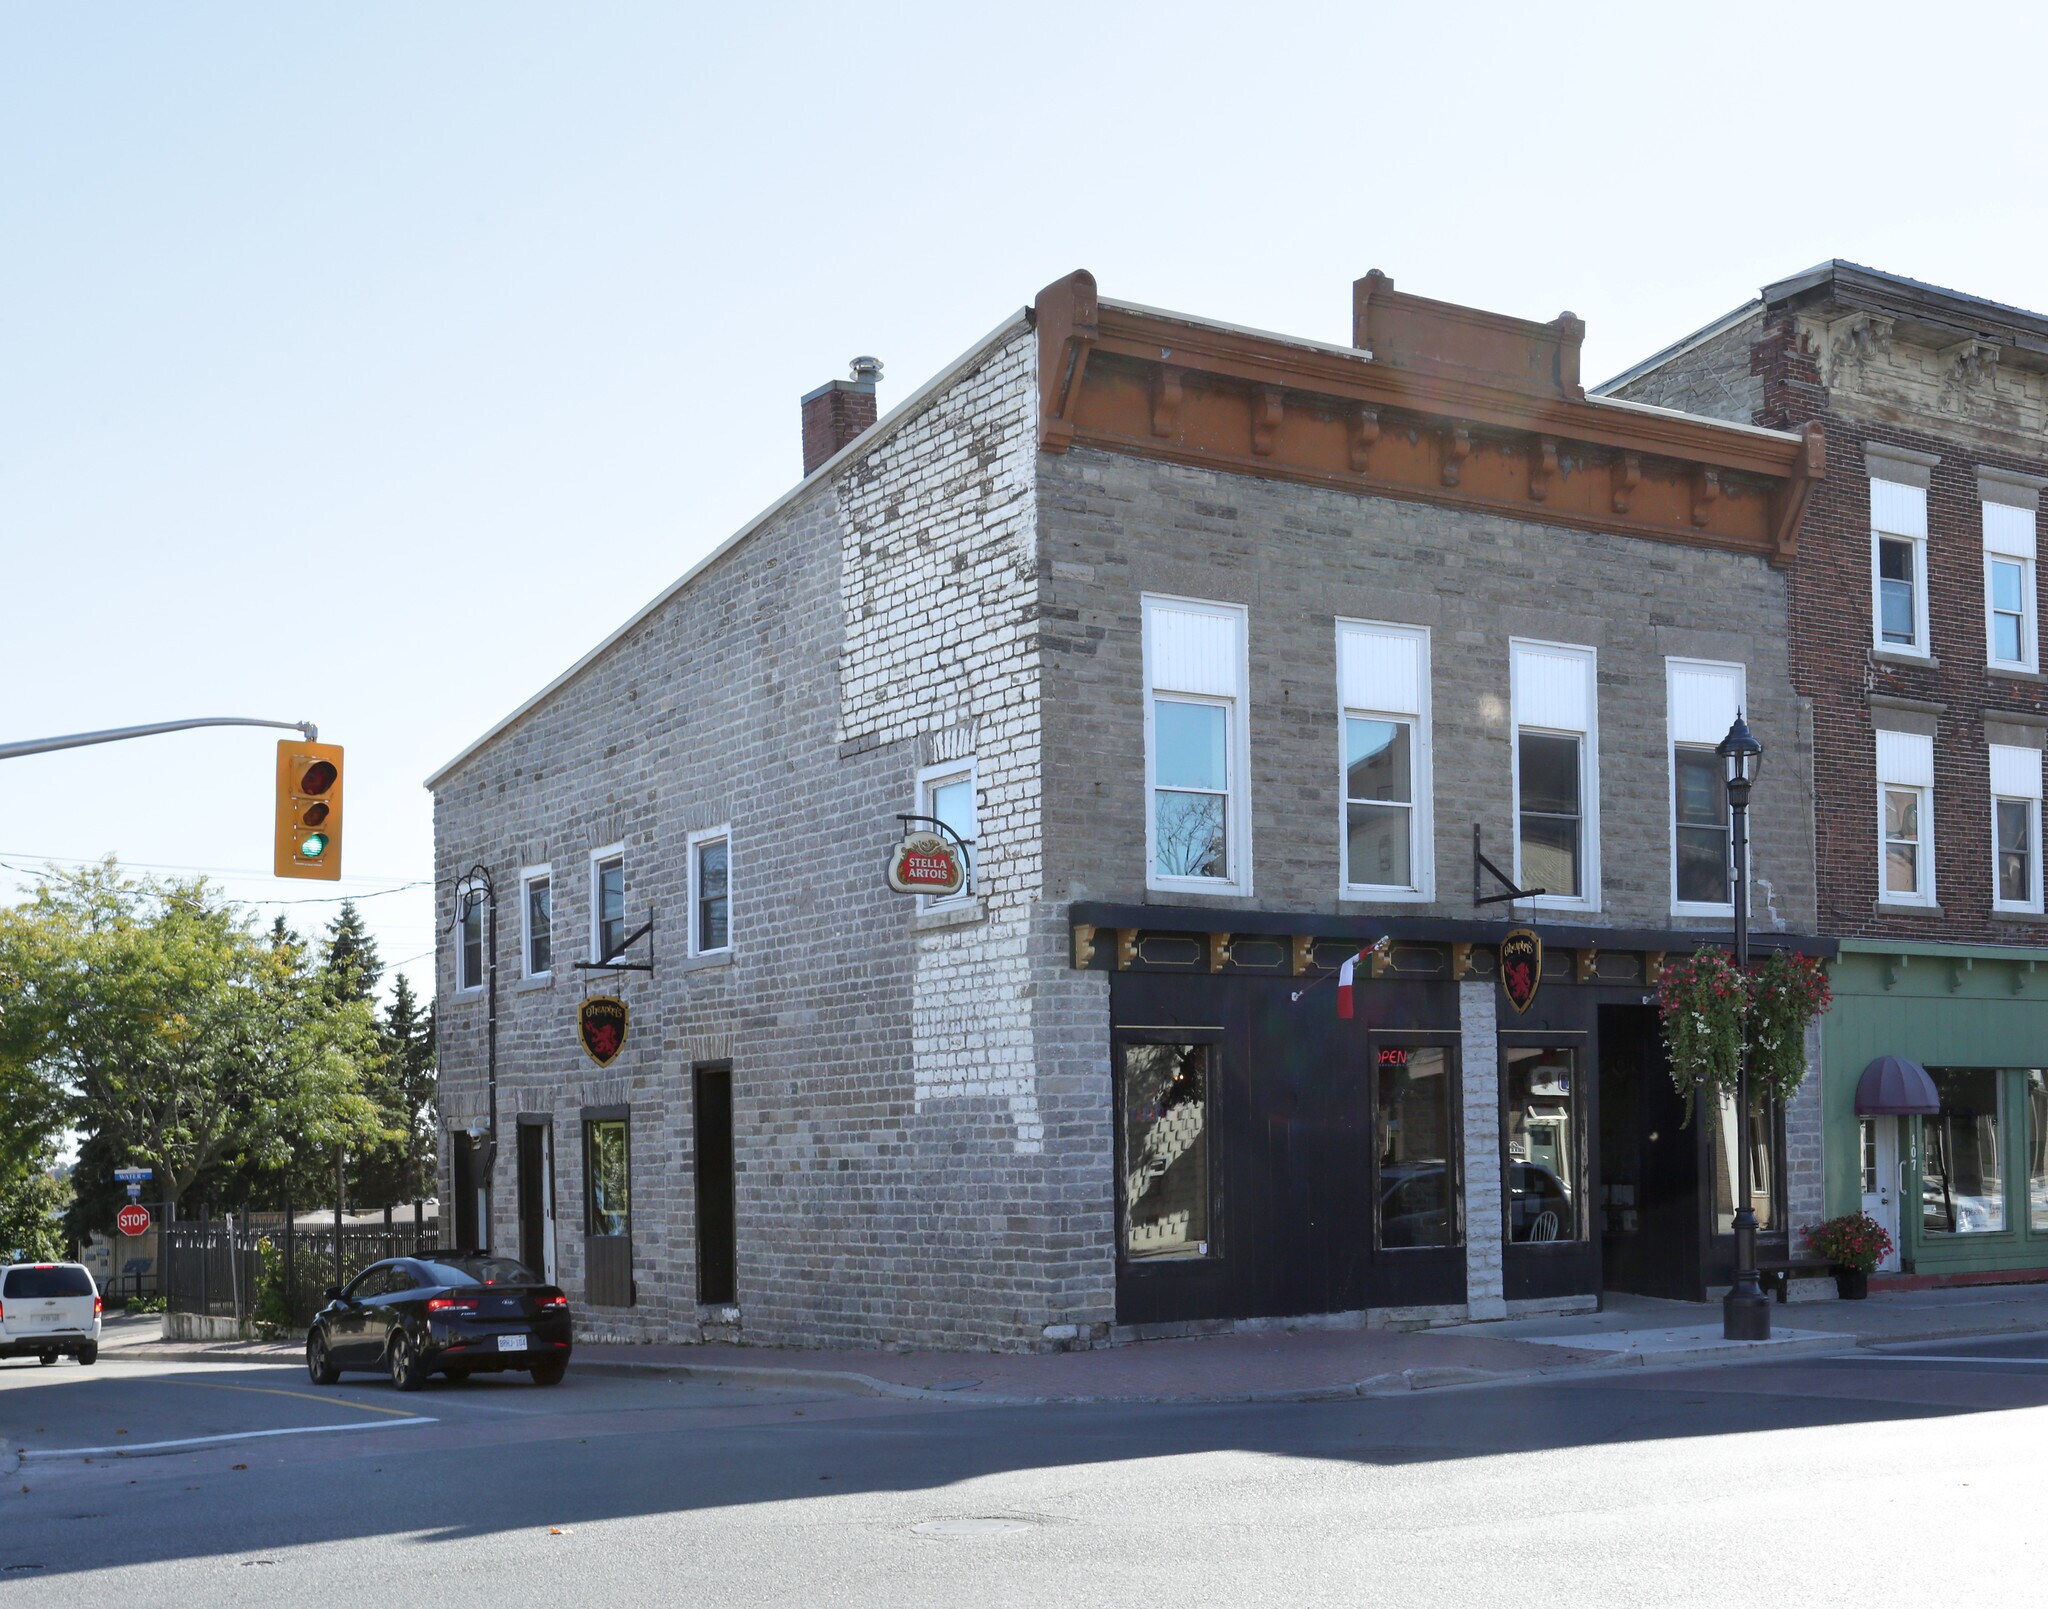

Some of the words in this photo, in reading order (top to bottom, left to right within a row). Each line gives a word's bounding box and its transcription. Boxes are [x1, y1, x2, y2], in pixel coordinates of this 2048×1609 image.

[909, 858, 947, 869] STELLA
[908, 868, 948, 880] ARTOIS
[120, 1213, 147, 1227] STOP
